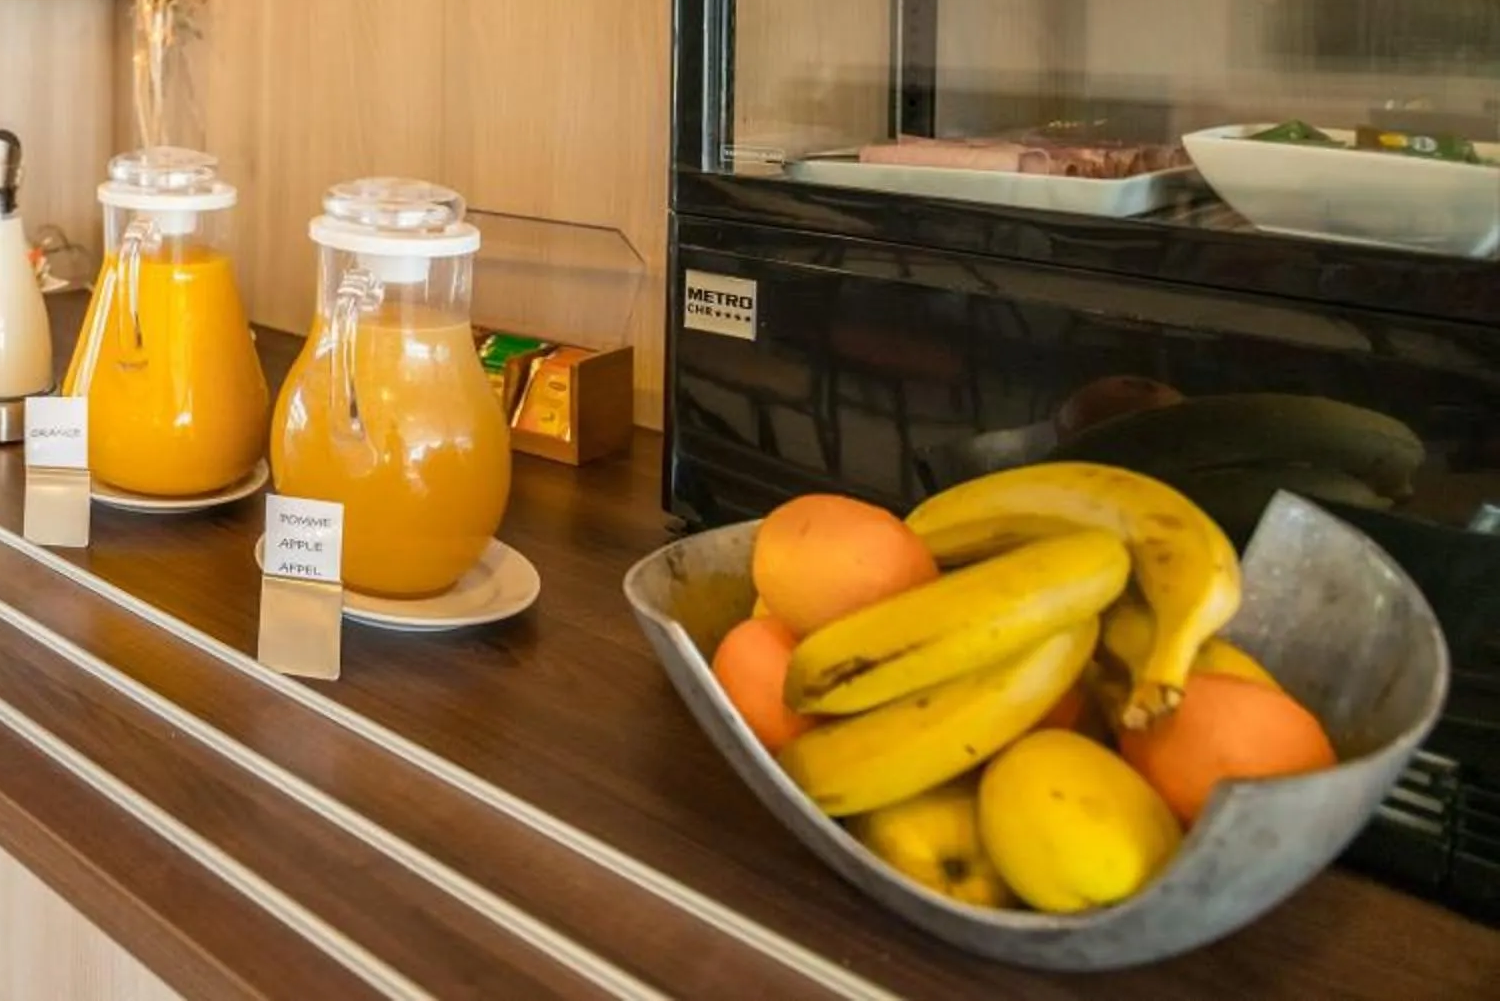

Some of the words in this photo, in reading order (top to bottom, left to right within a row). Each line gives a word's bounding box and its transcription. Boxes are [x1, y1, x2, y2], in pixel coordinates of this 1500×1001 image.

[687, 287, 754, 310] METRO
[279, 513, 332, 528] POMME
[277, 537, 324, 553] APPLE
[278, 562, 322, 576] APPEL
